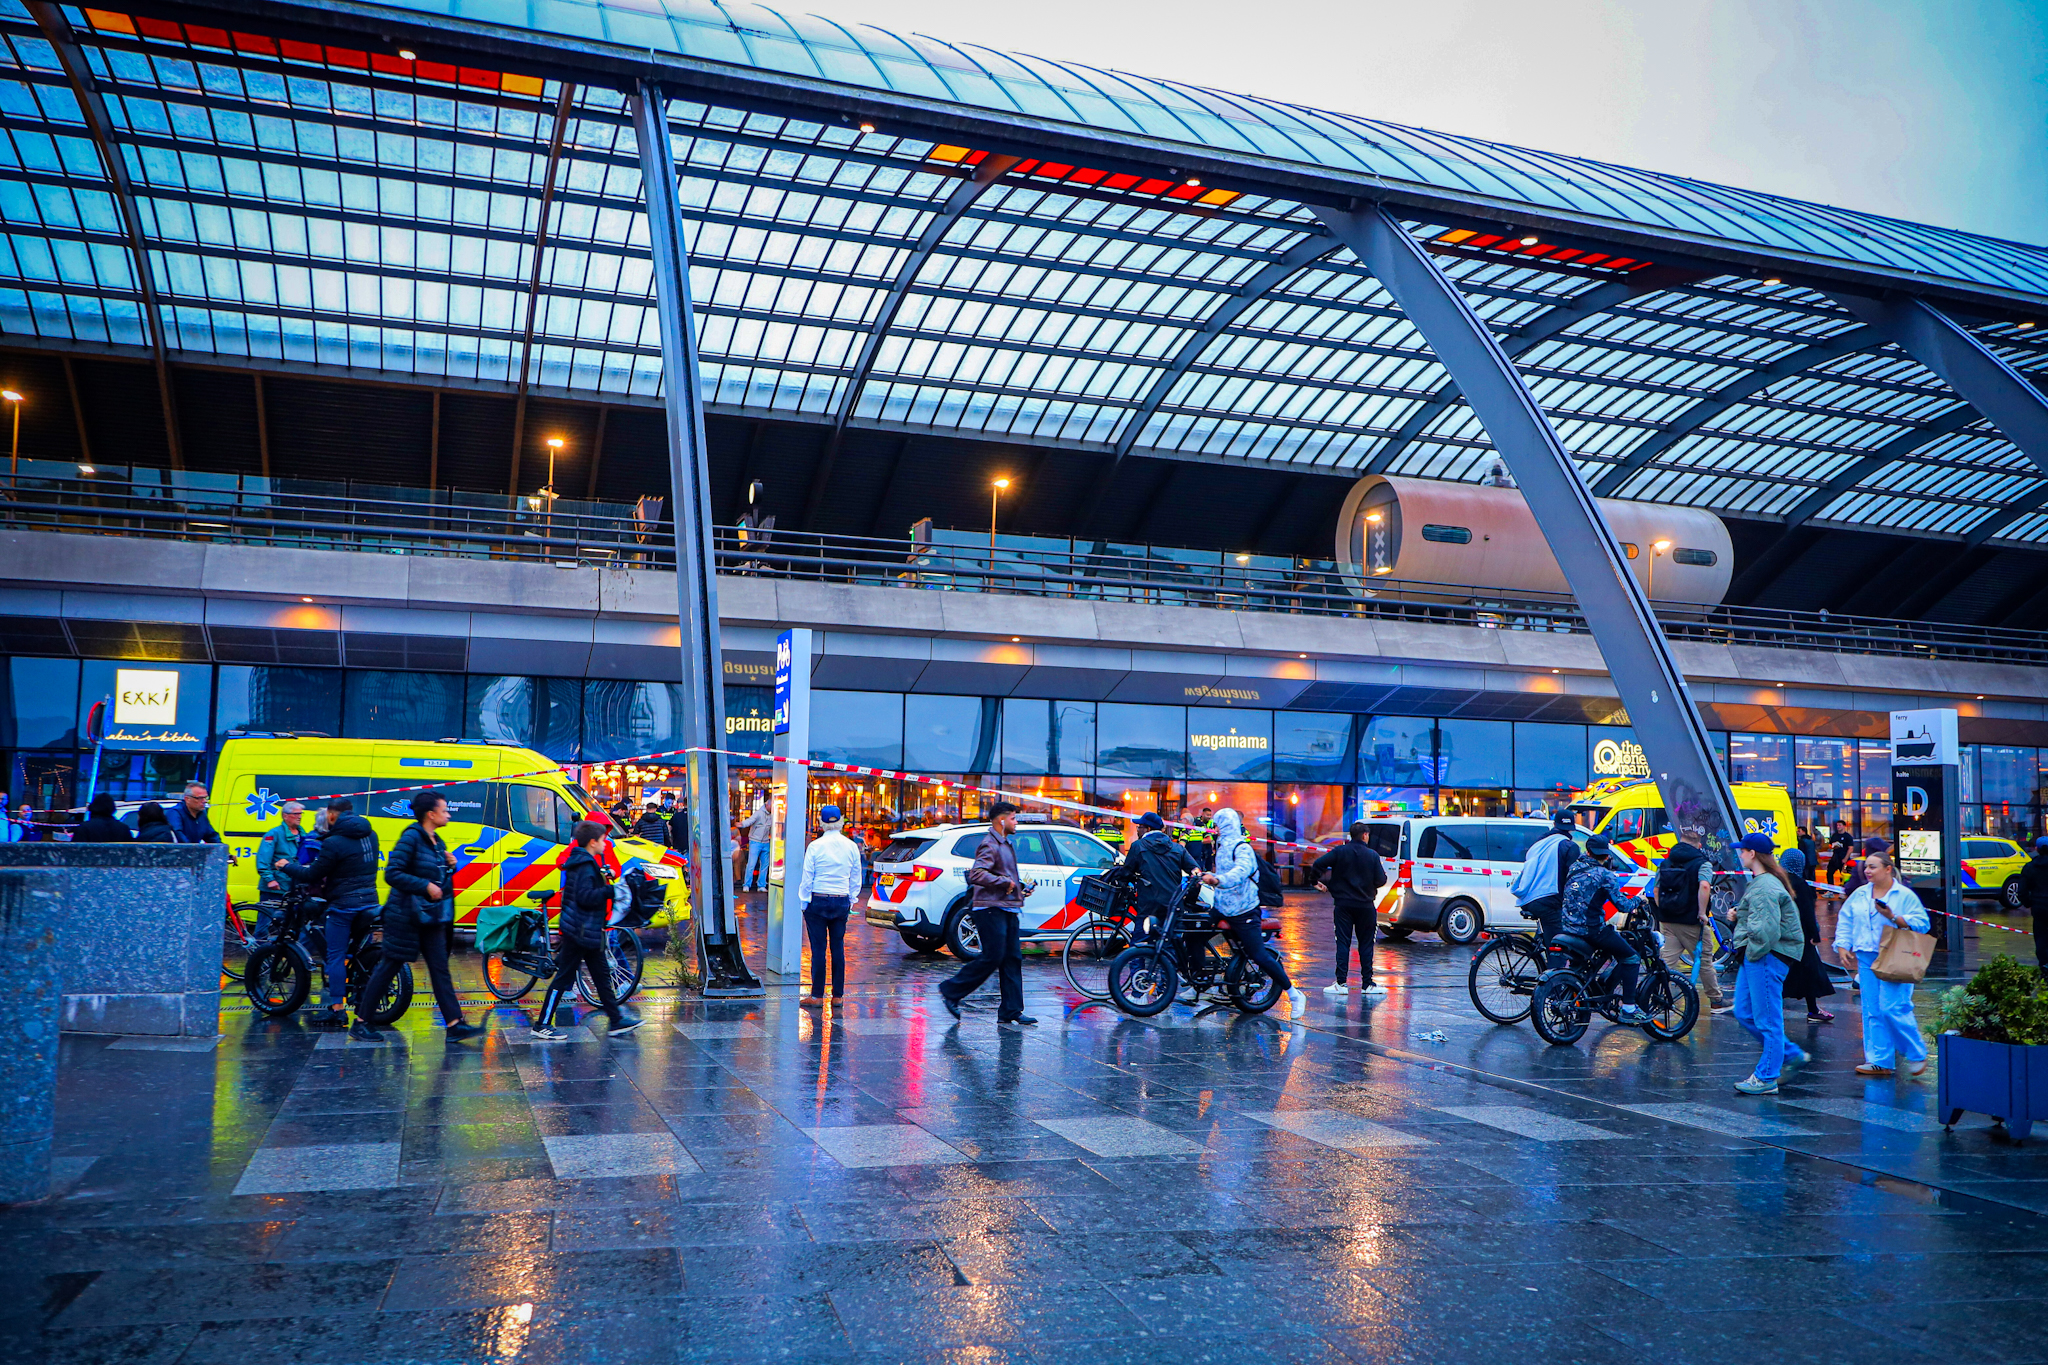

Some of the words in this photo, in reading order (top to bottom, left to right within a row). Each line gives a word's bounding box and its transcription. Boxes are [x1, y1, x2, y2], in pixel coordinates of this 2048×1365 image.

[105, 729, 156, 741] ature's
[159, 731, 200, 742] kitchen
[1190, 734, 1268, 751] wagamama
[1621, 740, 1643, 755] the
[1593, 763, 1652, 779] company
[448, 800, 482, 808] Amsterdam
[1906, 786, 1929, 816] D
[1039, 879, 1062, 888] ITIE
